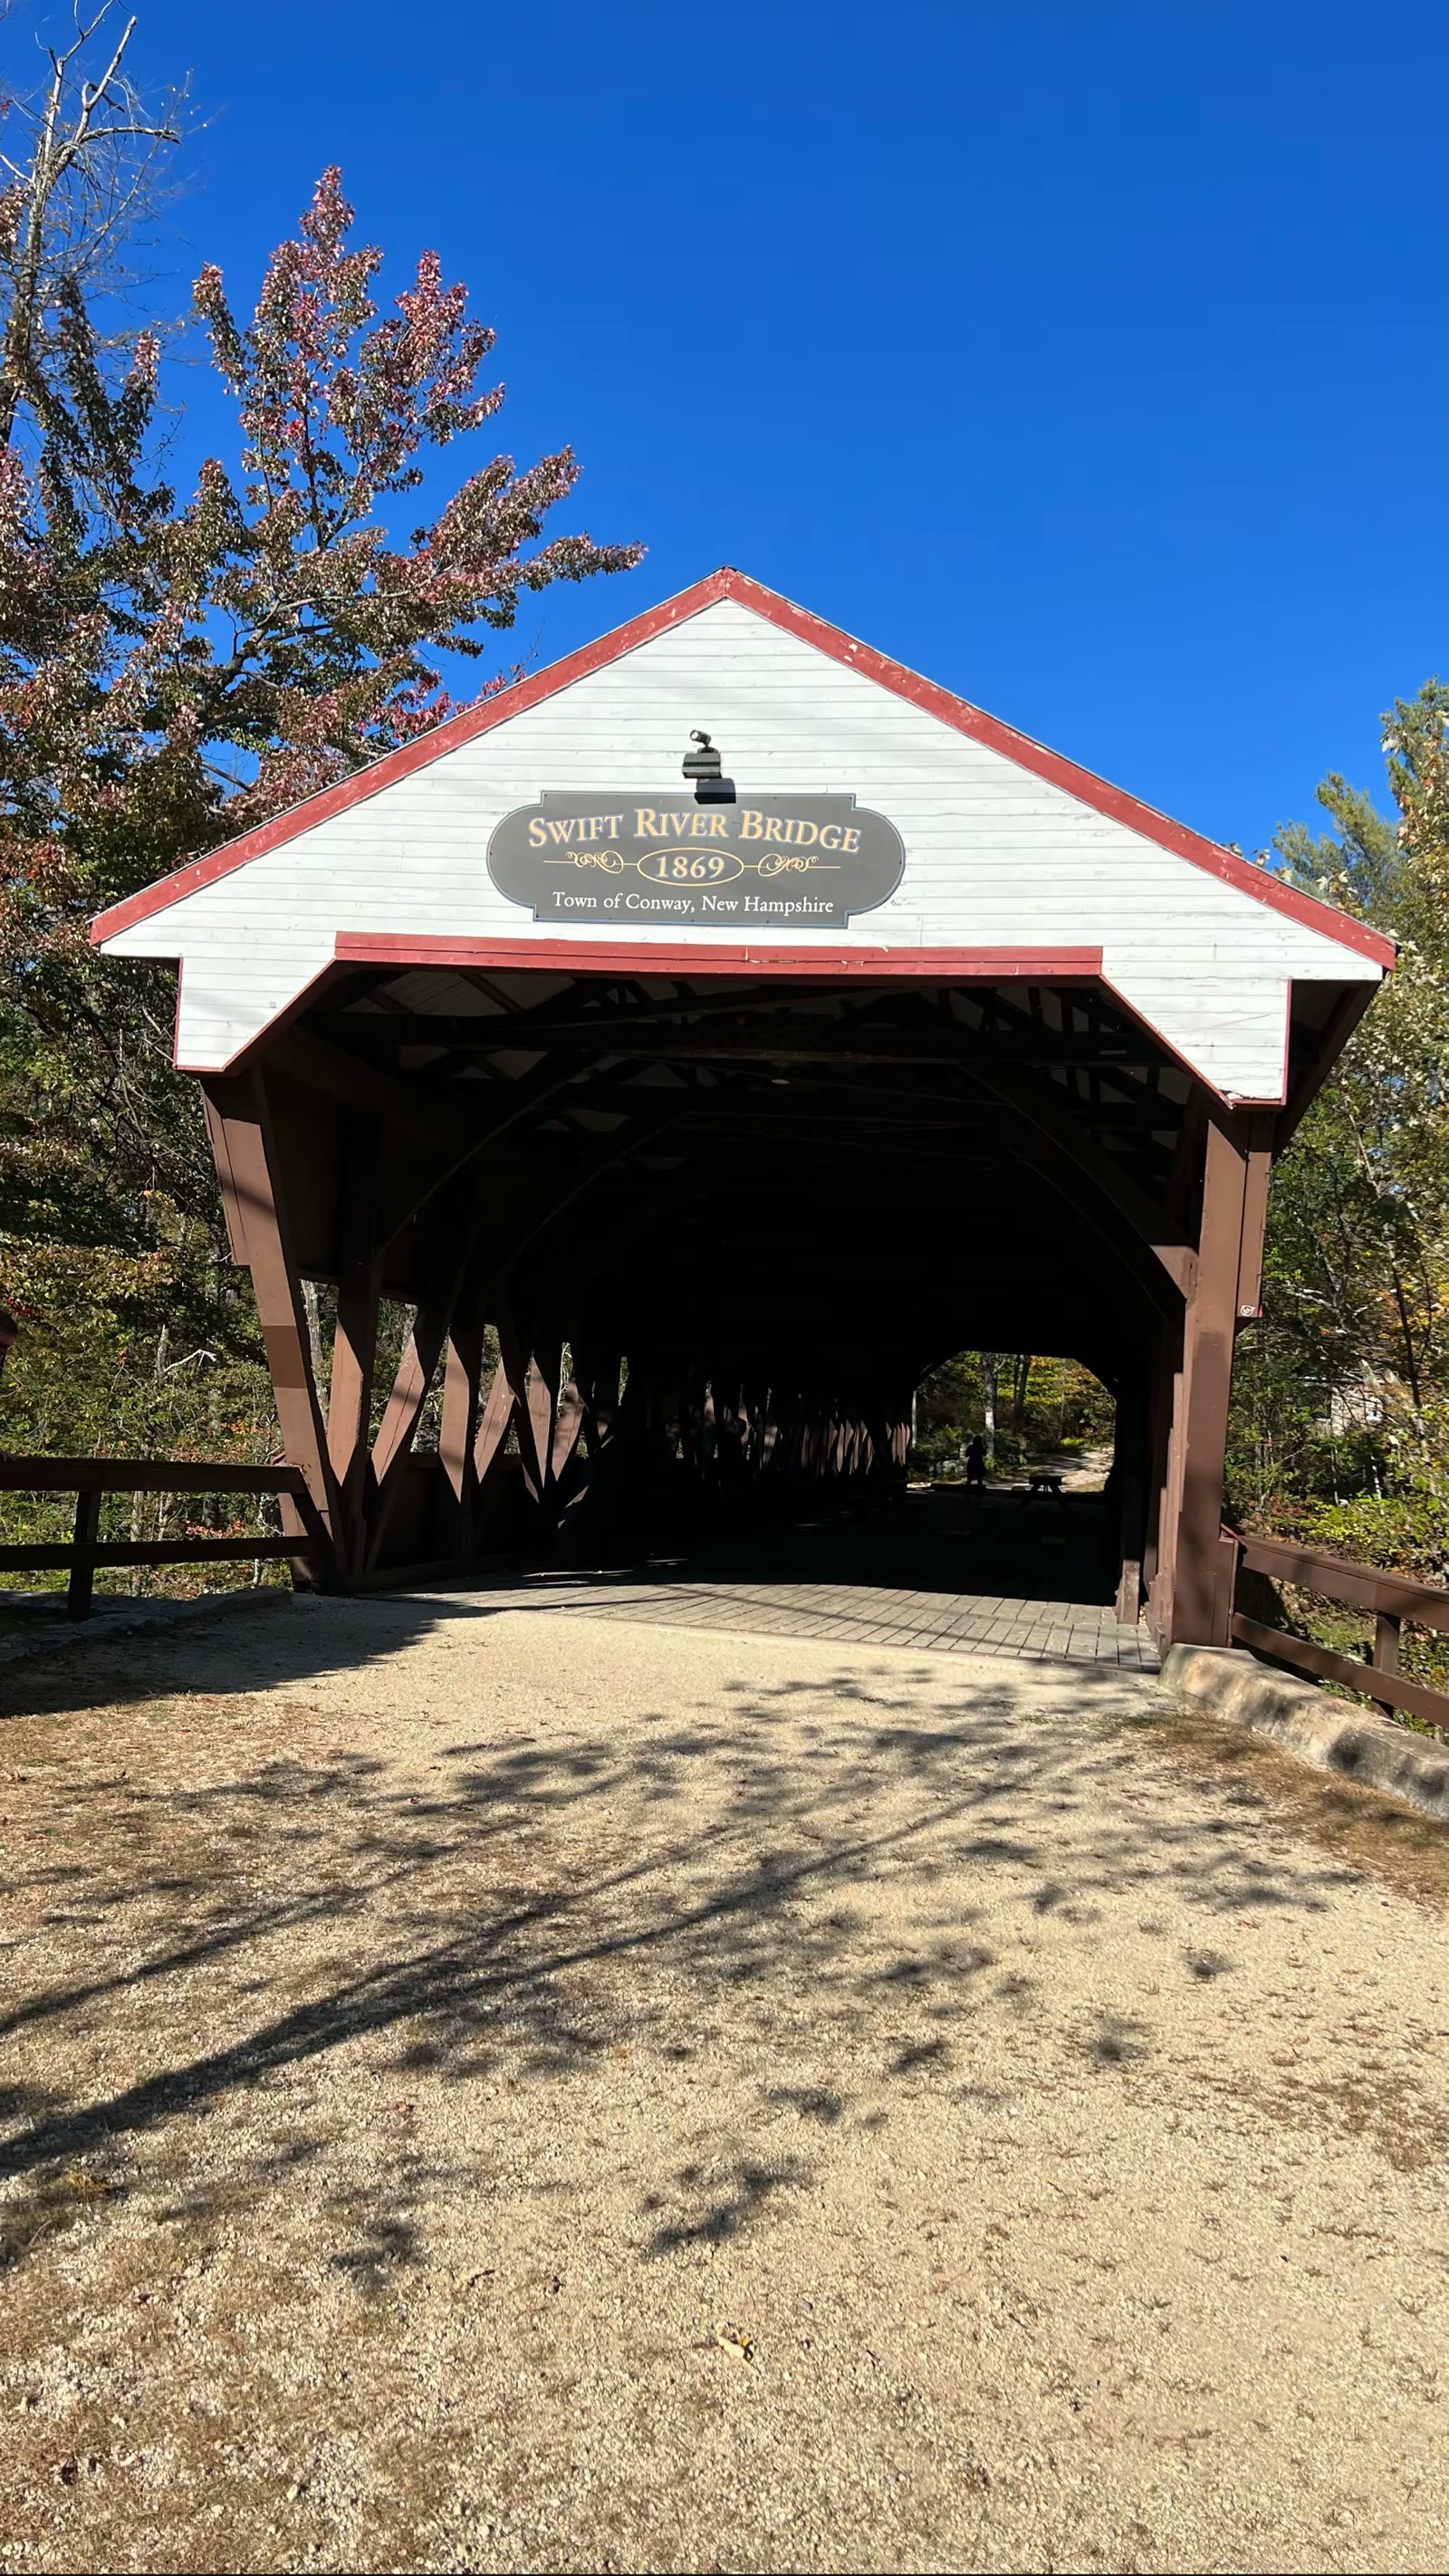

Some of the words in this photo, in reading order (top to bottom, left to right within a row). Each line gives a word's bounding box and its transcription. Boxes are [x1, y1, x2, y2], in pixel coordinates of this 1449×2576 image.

[527, 815, 623, 848] SWIFT
[634, 807, 728, 840] RIVER
[740, 810, 861, 853] BRIDGE
[655, 855, 725, 879] 1869
[552, 891, 597, 908] Town
[603, 892, 621, 908] of
[625, 894, 695, 914] Conway,
[701, 896, 738, 912] New
[743, 897, 834, 918] Hampshire
